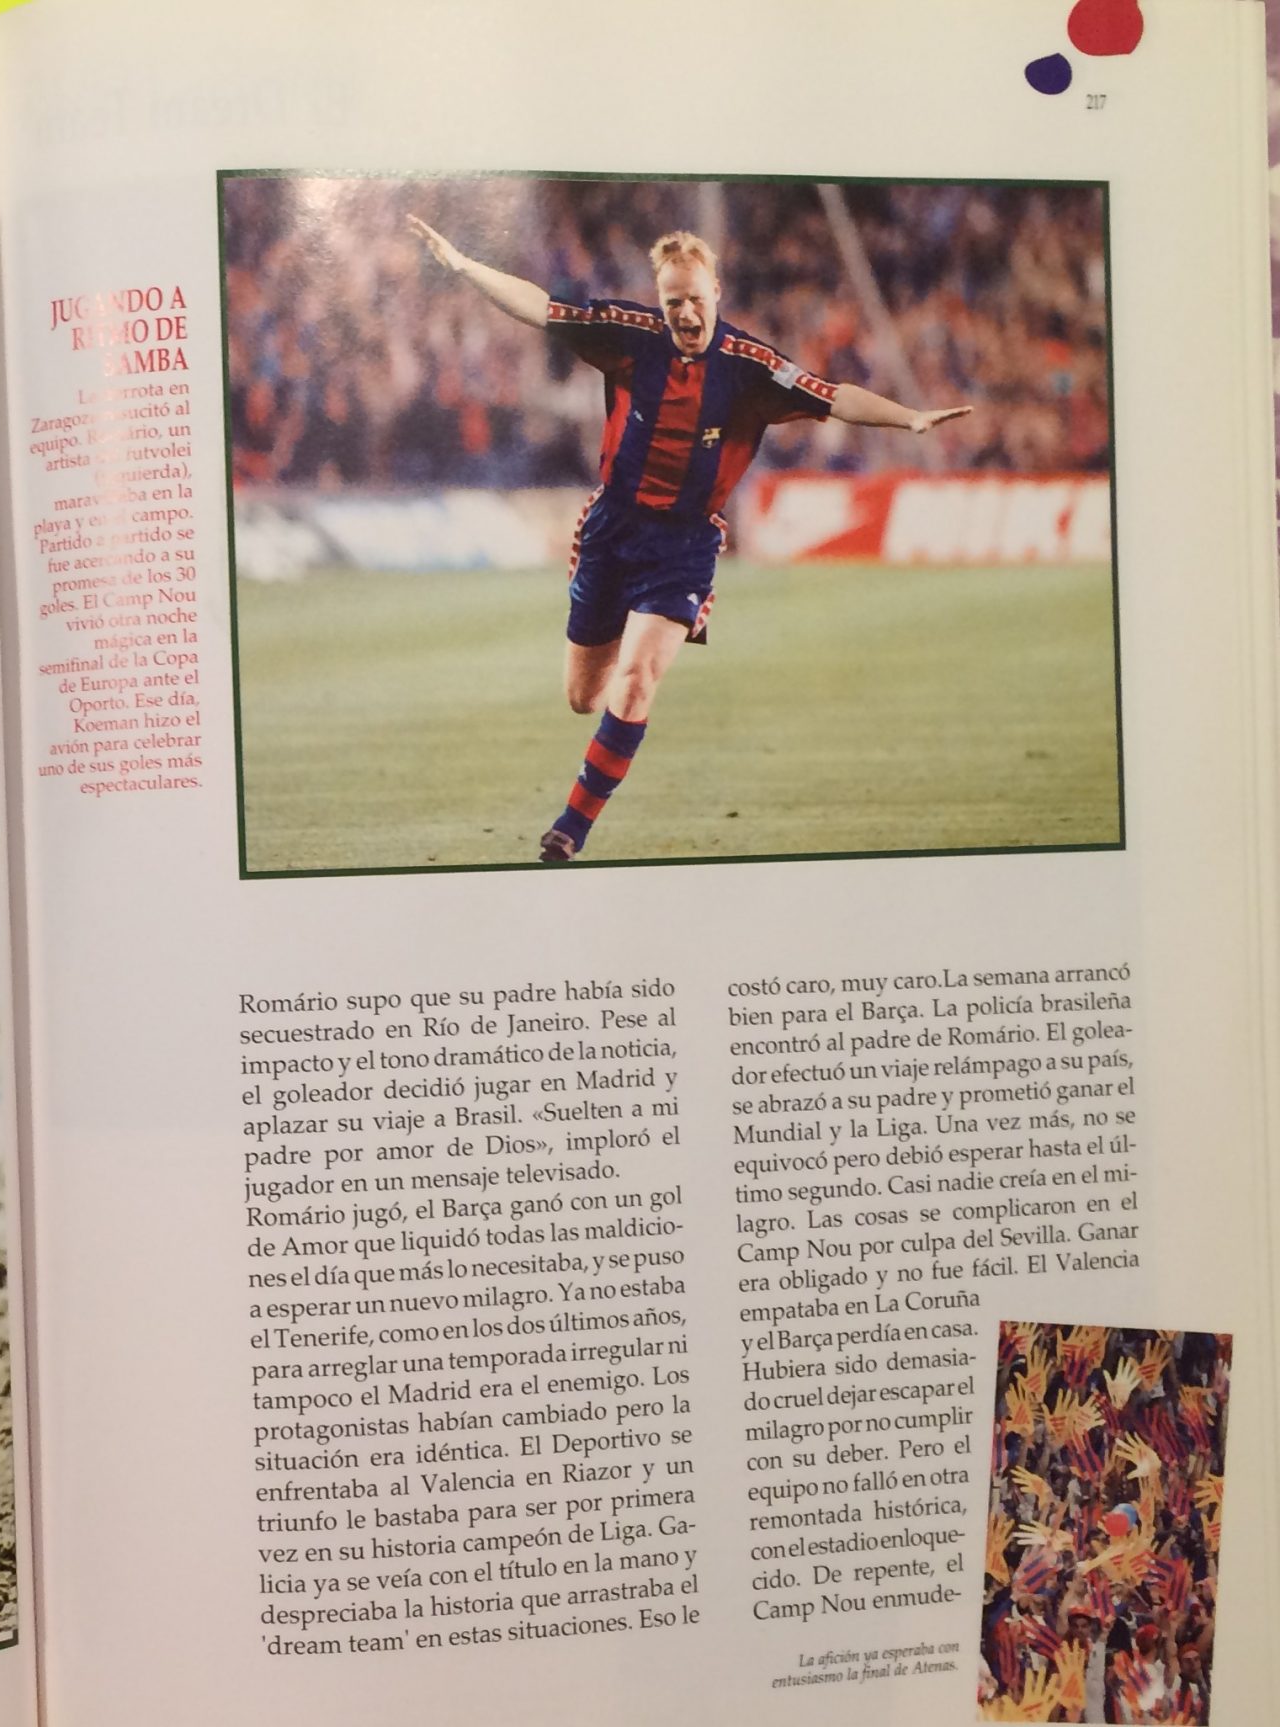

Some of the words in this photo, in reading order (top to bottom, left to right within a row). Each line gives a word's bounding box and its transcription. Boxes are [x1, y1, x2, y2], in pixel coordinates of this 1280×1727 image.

[1086, 93, 1107, 110] 217
[50, 287, 163, 331] JUGNDO
[170, 285, 187, 309] A
[72, 319, 149, 351] RIMO
[155, 316, 188, 341] DE
[104, 347, 189, 376] AMBA
[33, 518, 71, 540] playa
[74, 517, 85, 535] y
[131, 507, 194, 525] campo.
[40, 533, 92, 554] Partido
[96, 536, 105, 546] a
[176, 528, 195, 540] se
[48, 557, 70, 573] fue
[160, 551, 170, 562] a
[174, 549, 195, 561] su
[121, 570, 143, 585] de
[147, 568, 172, 583] los
[176, 566, 196, 582] 30
[39, 599, 79, 620] goles.
[83, 594, 98, 609] El
[102, 592, 153, 610] Camp
[158, 588, 196, 603] Nou
[66, 613, 105, 632] vivió
[108, 616, 141, 628] otra
[146, 607, 198, 625] noche
[94, 632, 152, 652] mágica
[156, 633, 178, 645] en
[182, 628, 198, 643] la
[38, 655, 104, 676] semifinal
[108, 653, 129, 669] de
[133, 652, 148, 667] la
[153, 650, 199, 670] Copa
[58, 678, 77, 694] de
[80, 675, 138, 694] Europa
[143, 671, 180, 687] ante
[184, 669, 199, 685] el
[69, 697, 129, 717] Oporto.
[135, 693, 163, 708] Ese
[168, 690, 200, 707] día,
[73, 717, 138, 734] Koeman
[144, 712, 181, 728] hizo
[185, 710, 201, 726] el
[49, 739, 89, 756] avión
[93, 740, 129, 757] para
[133, 733, 202, 750] celebrar
[38, 763, 64, 777] uno
[67, 759, 86, 774] de
[89, 760, 115, 772] sus
[119, 755, 163, 775] goles
[167, 753, 203, 768] más
[80, 774, 203, 798] espectaculares.
[239, 992, 338, 1013] Romário
[347, 994, 401, 1015] supo
[410, 992, 450, 1014] que
[460, 992, 484, 1005] su
[494, 983, 556, 1010] padre
[564, 980, 622, 1000] había
[632, 978, 674, 998] sido
[728, 1007, 773, 1026] bien
[782, 1009, 827, 1030] para
[836, 1002, 853, 1021] el
[862, 1002, 924, 1024] Barça.
[932, 999, 958, 1016] La
[966, 996, 1033, 1022] policía
[1040, 992, 1131, 1012] brasileña
[244, 1115, 328, 1142] aplazar
[338, 1118, 364, 1132] su
[372, 1110, 424, 1136] viaje
[434, 1114, 446, 1127] a
[455, 1104, 522, 1126] Brasil.
[533, 1100, 622, 1122] «Suelten
[632, 1104, 642, 1117] a
[652, 1096, 678, 1116] mi
[734, 1121, 822, 1144] Mundial
[830, 1126, 842, 1146] y
[850, 1119, 868, 1138] la
[876, 1118, 927, 1142] Liga.
[936, 1115, 978, 1134] Una
[986, 1117, 1020, 1130] vez
[1029, 1110, 1074, 1129] más,
[1084, 1112, 1108, 1126] no
[1116, 1111, 1136, 1124] se
[248, 1237, 276, 1257] de
[282, 1237, 348, 1256] Amor
[354, 1238, 395, 1260] que
[401, 1228, 480, 1256] liquidó
[486, 1224, 544, 1246] todas
[550, 1222, 579, 1242] las
[585, 1216, 683, 1240] maldicio-
[738, 1243, 799, 1266] Camp
[806, 1239, 852, 1258] Nou
[860, 1240, 894, 1262] por
[901, 1232, 956, 1257] culpa
[963, 1228, 994, 1248] del
[1000, 1224, 1070, 1246] Sevilla.
[1078, 1222, 1138, 1242] Ganar
[252, 1364, 303, 1386] para
[308, 1355, 398, 1382] arreglar
[402, 1357, 444, 1372] una
[448, 1343, 567, 1374] temporada
[572, 1337, 664, 1365] irregular
[668, 1334, 688, 1354] ni
[742, 1360, 826, 1381] Hubiera
[835, 1354, 877, 1374] sido
[886, 1348, 976, 1370] demasia-
[255, 1450, 359, 1470] situación
[370, 1452, 404, 1466] era
[416, 1440, 508, 1464] idéntica.
[520, 1435, 541, 1456] El
[552, 1429, 660, 1458] Deportivo
[672, 1430, 692, 1444] se
[258, 1549, 298, 1562] vez
[306, 1548, 332, 1562] en
[340, 1546, 364, 1560] su
[372, 1536, 456, 1558] historia
[463, 1528, 562, 1556] campeón
[568, 1524, 594, 1544] de
[600, 1521, 652, 1546] Liga.
[658, 1516, 696, 1535] Ga-
[754, 1600, 814, 1622] Camp
[821, 1594, 866, 1614] Nou
[872, 1584, 962, 1609] enmude-
[262, 1635, 342, 1655] 'dream
[348, 1630, 408, 1652] team'
[416, 1634, 442, 1648] en
[449, 1626, 502, 1646] estas
[508, 1616, 632, 1640] situaciones.
[639, 1609, 676, 1628] Eso
[682, 1605, 700, 1624] le
[799, 1654, 814, 1668] La
[818, 1649, 860, 1669] afición
[864, 1650, 878, 1666] ya
[882, 1642, 935, 1662] esperaba
[938, 1642, 959, 1653] con
[772, 1671, 843, 1688] entusiasmo
[847, 1667, 858, 1681] la
[859, 1664, 890, 1684] final
[894, 1663, 909, 1676] de
[912, 1661, 958, 1674] Atenas.
